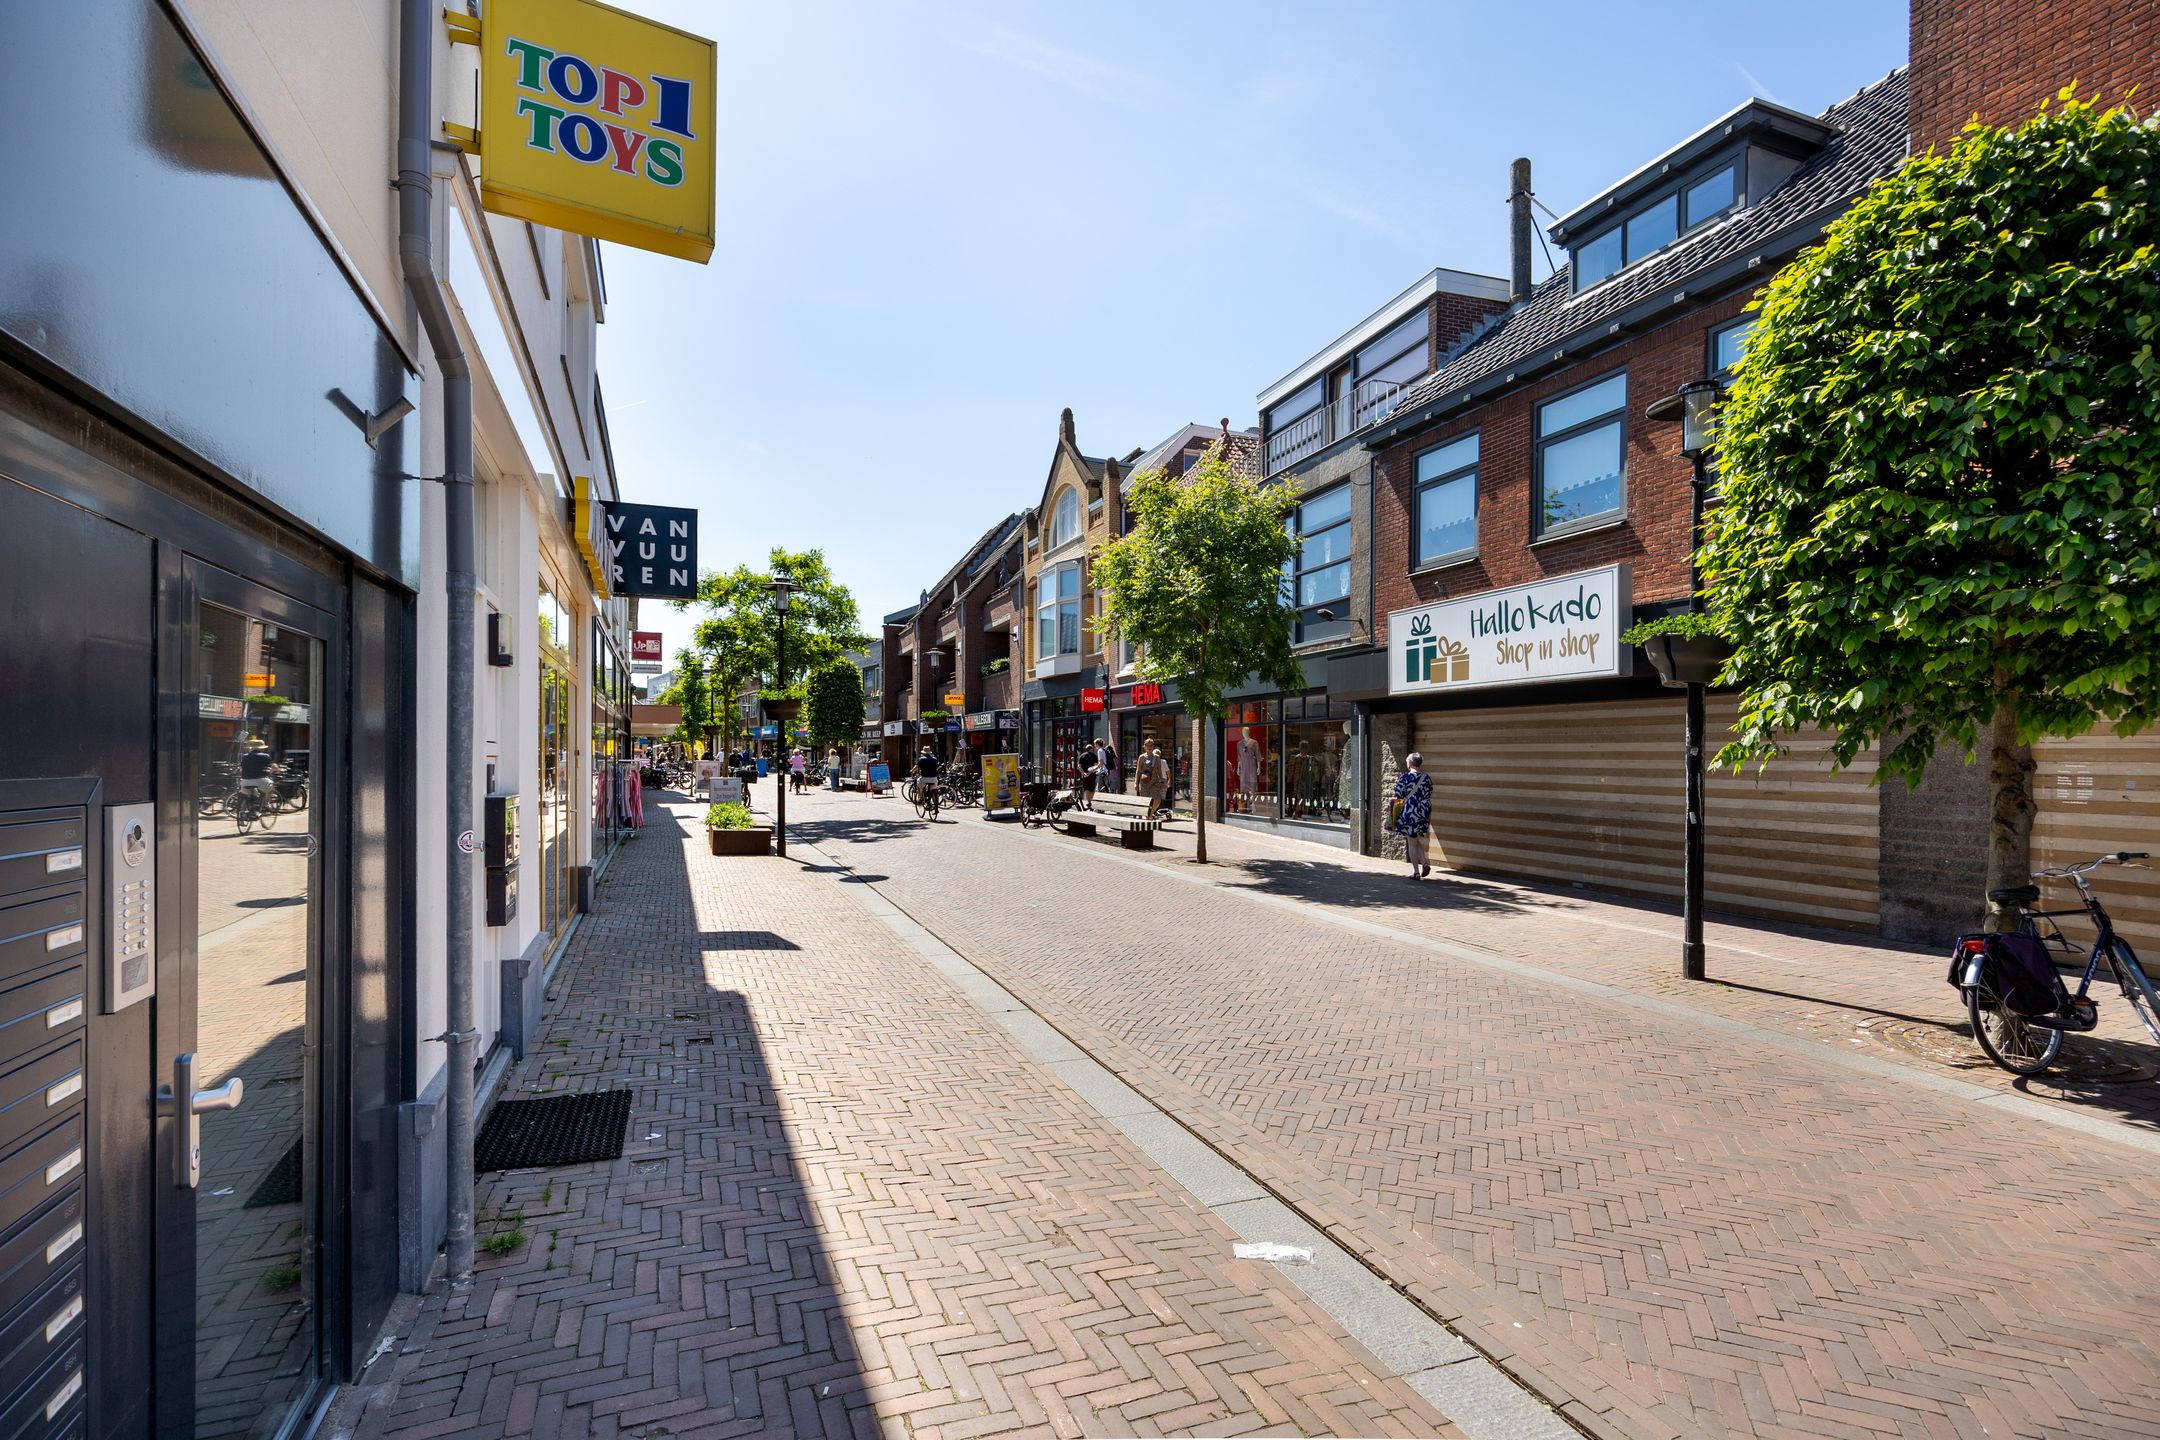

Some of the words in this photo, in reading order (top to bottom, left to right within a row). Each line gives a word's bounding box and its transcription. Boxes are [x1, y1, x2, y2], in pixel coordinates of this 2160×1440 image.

[517, 97, 685, 188] TOYS
[607, 514, 688, 538] VAN
[608, 539, 687, 562] VUU
[612, 564, 688, 587] REN
[1539, 640, 1553, 660] in
[1559, 627, 1600, 664] shop
[1084, 696, 1104, 704] HEMA
[1131, 682, 1163, 706] HEMA
